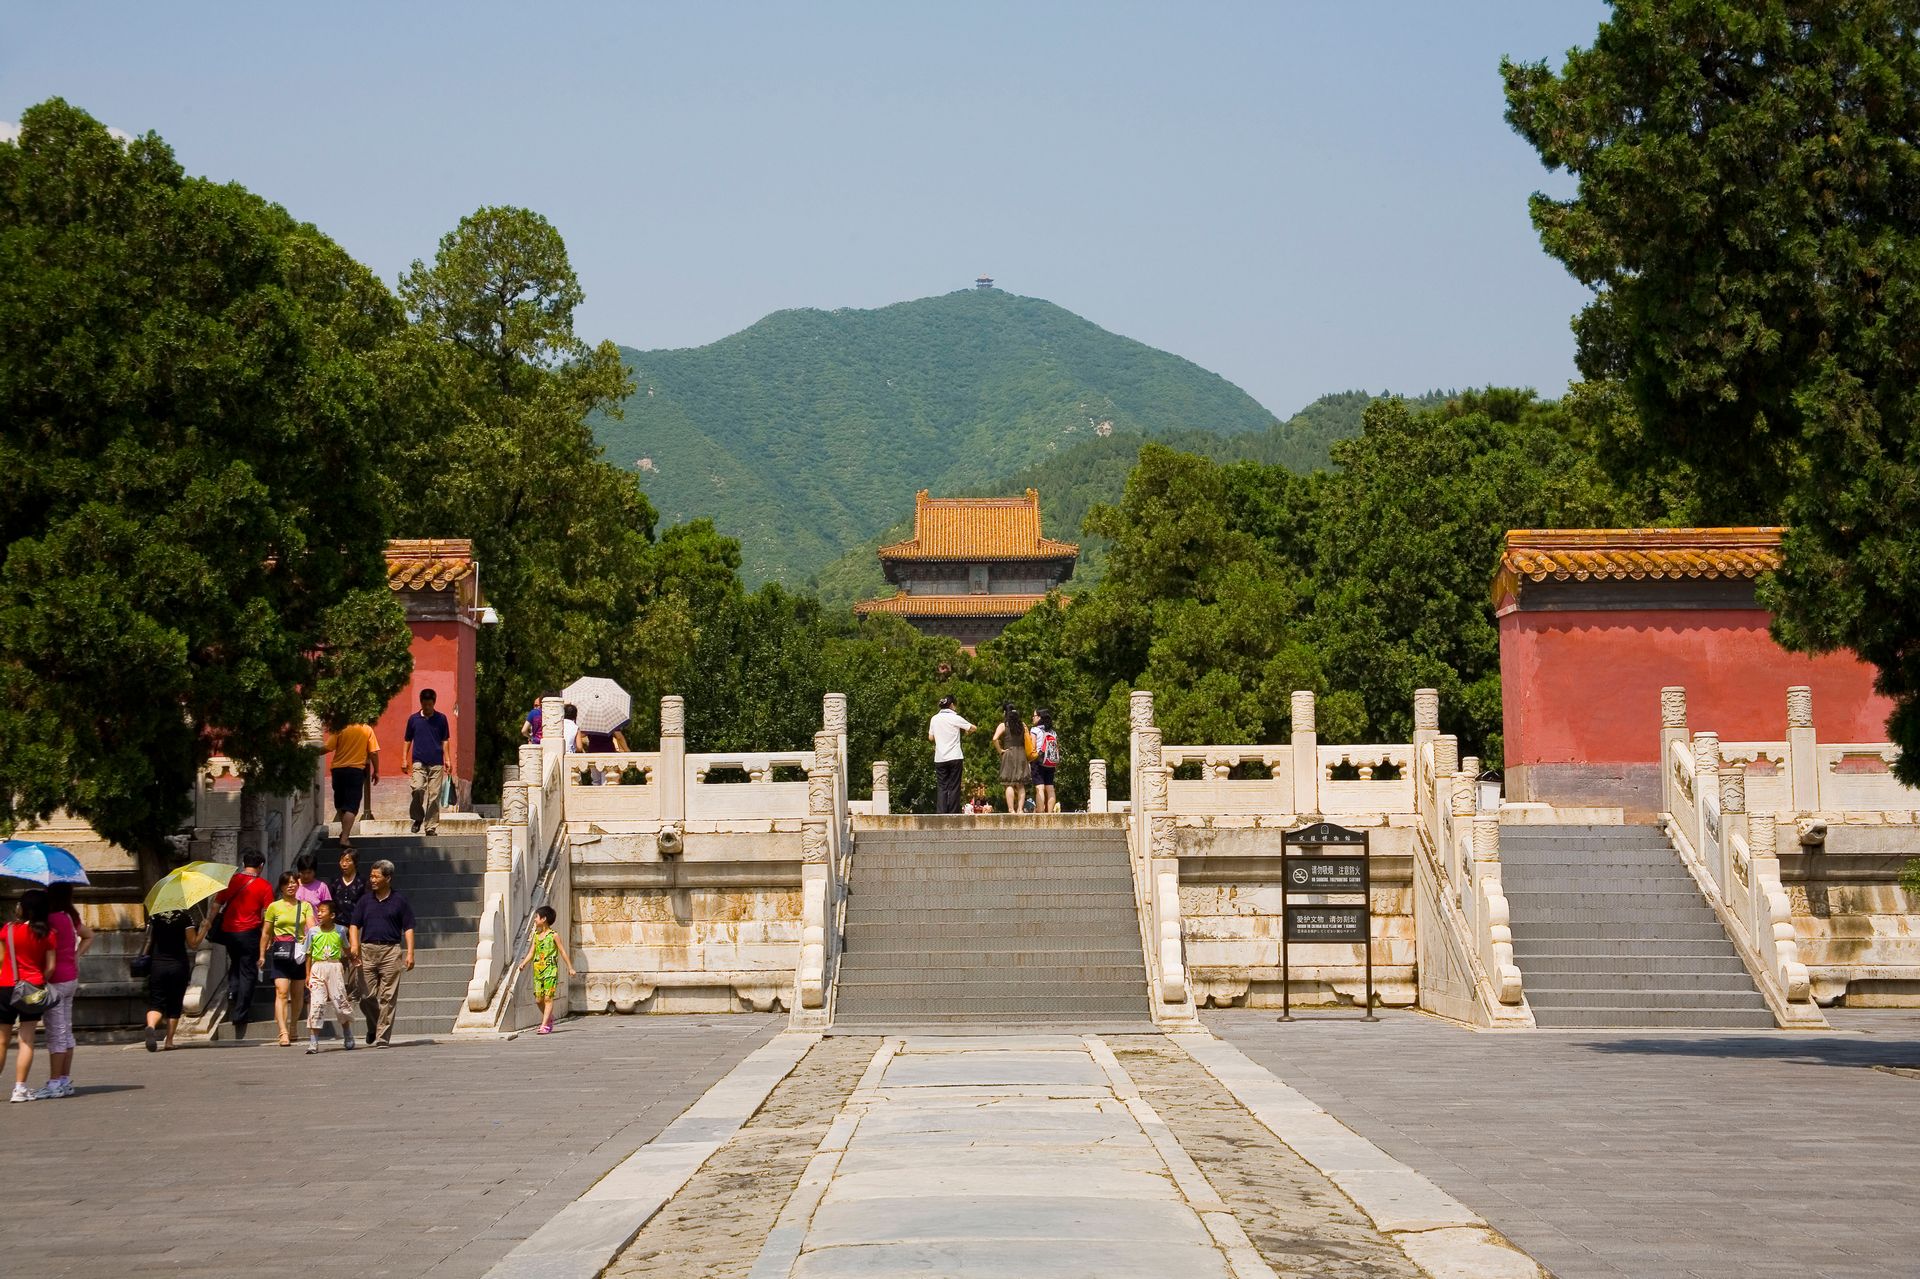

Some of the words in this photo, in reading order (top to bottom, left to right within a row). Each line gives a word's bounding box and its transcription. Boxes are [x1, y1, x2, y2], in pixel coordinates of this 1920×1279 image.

[1311, 865, 1334, 875] 请勿吸烟
[1338, 865, 1361, 875] 注意防火
[1296, 915, 1325, 924] 爱护文物
[1328, 915, 1357, 924] 请勿刻划
